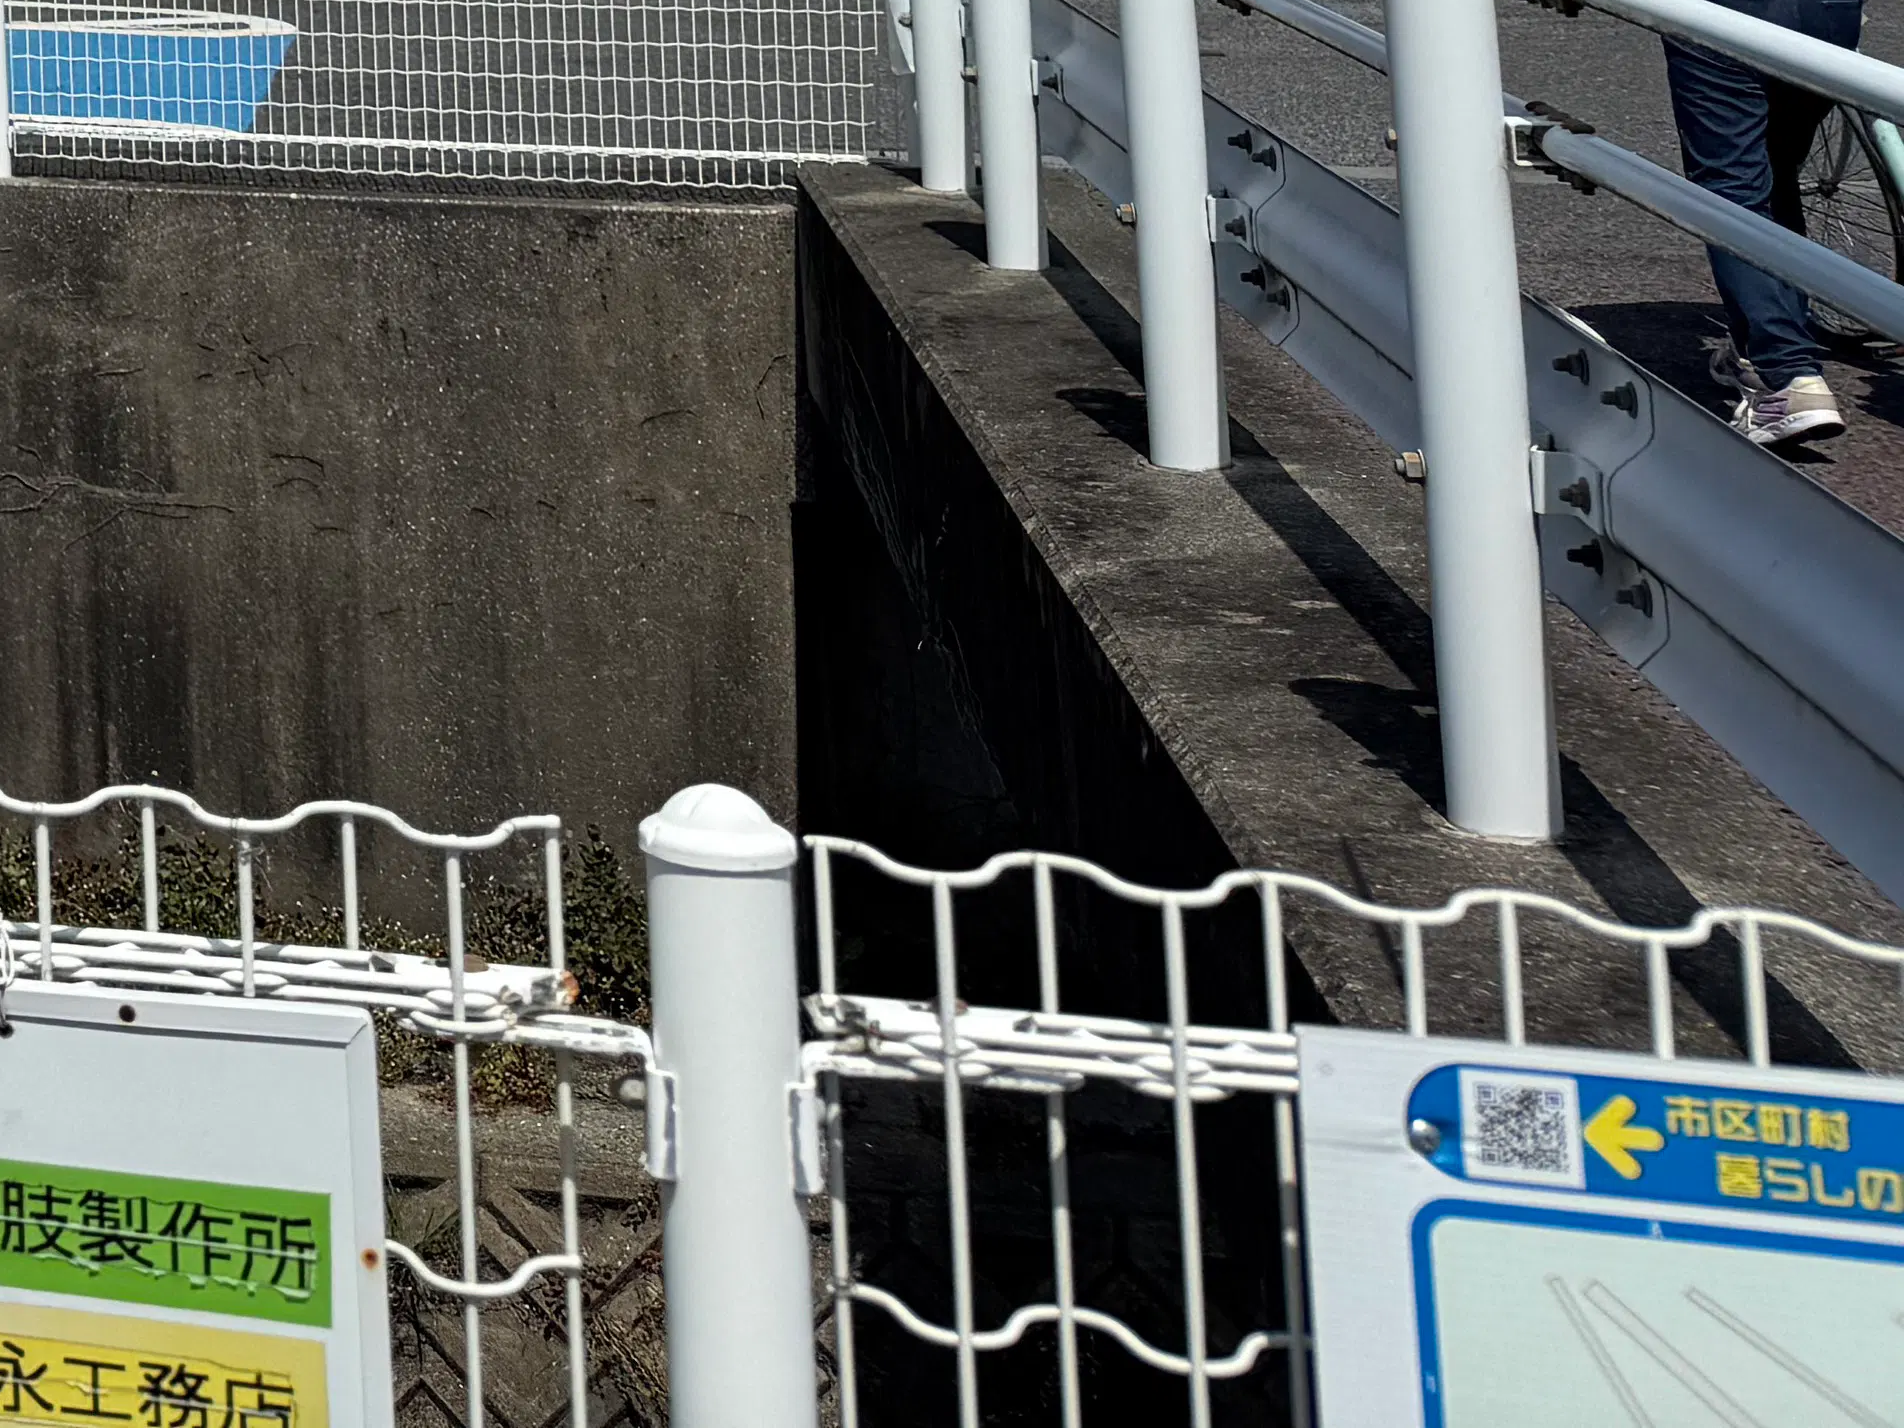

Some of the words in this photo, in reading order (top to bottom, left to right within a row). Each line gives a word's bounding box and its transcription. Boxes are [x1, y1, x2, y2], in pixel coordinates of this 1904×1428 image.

[1664, 1095, 1851, 1153] 市区町村
[1716, 1151, 1904, 1214] 暮らしの
